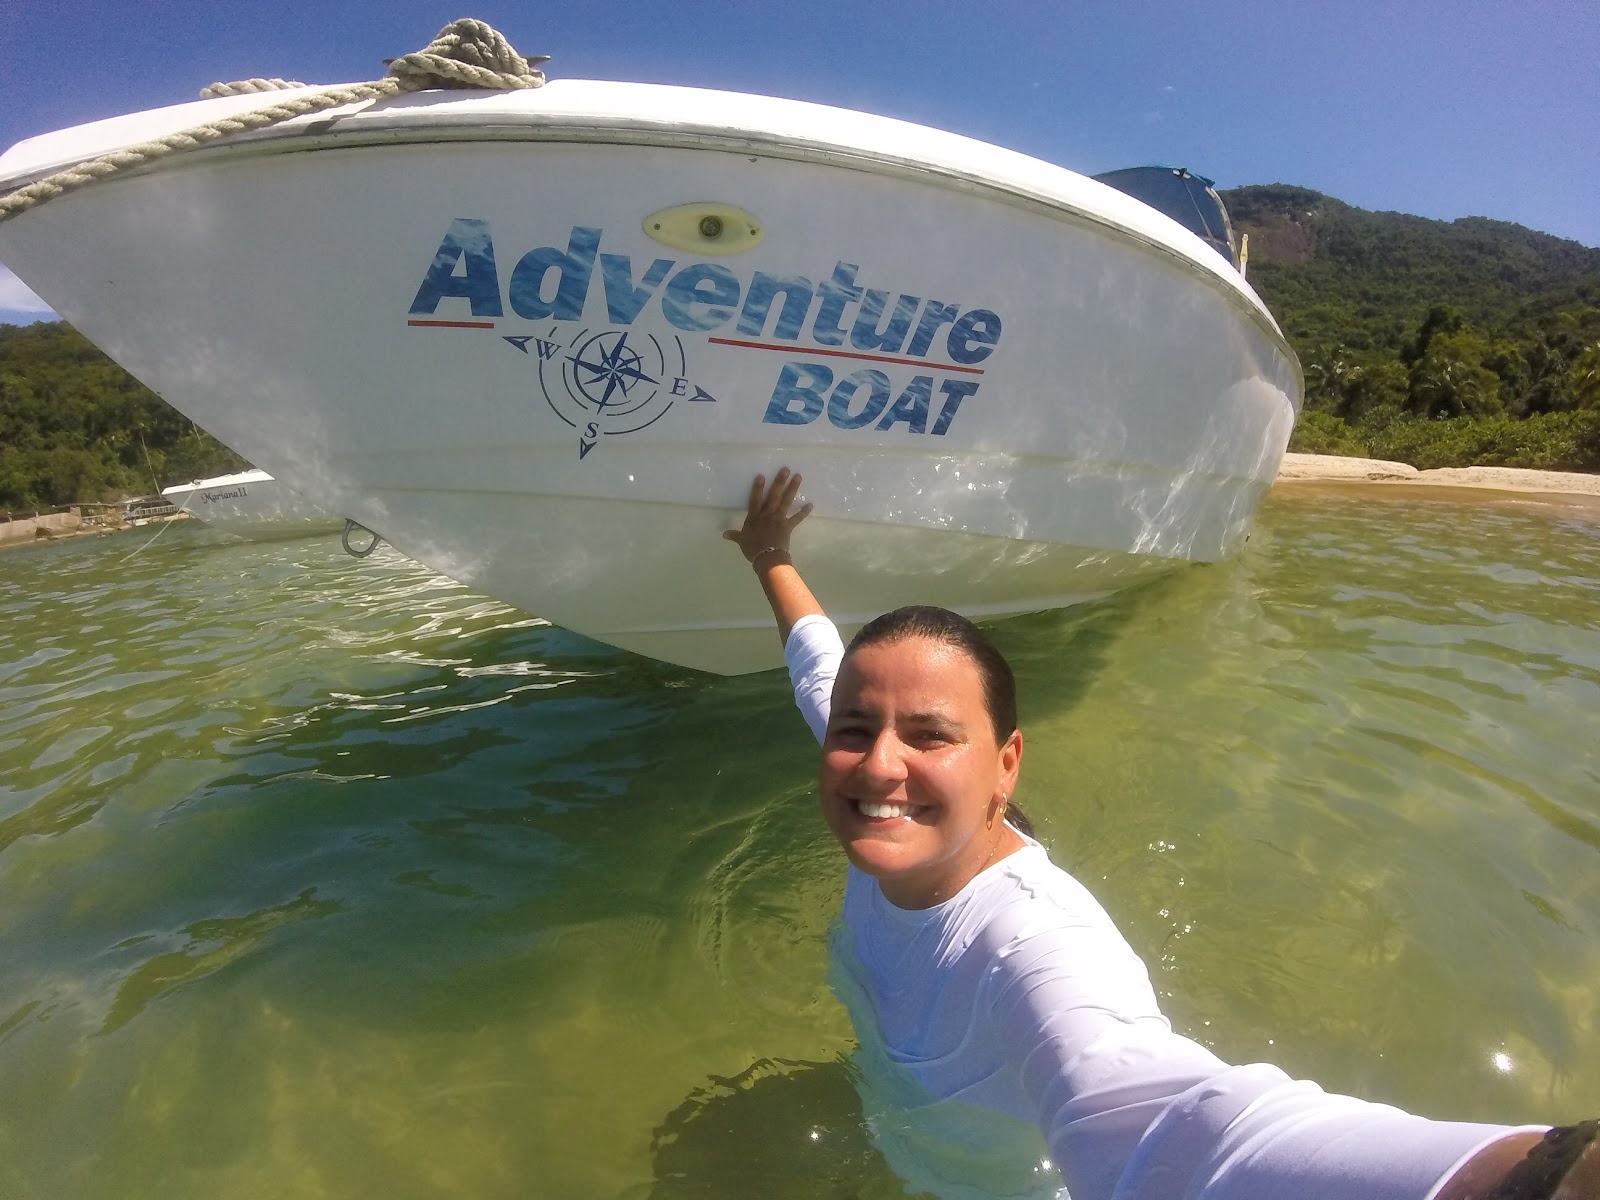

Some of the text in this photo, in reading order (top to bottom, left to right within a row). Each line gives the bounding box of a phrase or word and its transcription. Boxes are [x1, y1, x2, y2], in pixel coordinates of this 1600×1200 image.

[408, 218, 1002, 364] Adventure
[534, 338, 562, 361] W
[669, 377, 689, 397] E
[762, 362, 979, 436] BOAT
[584, 422, 600, 439] S
[201, 491, 239, 504] Mariana
